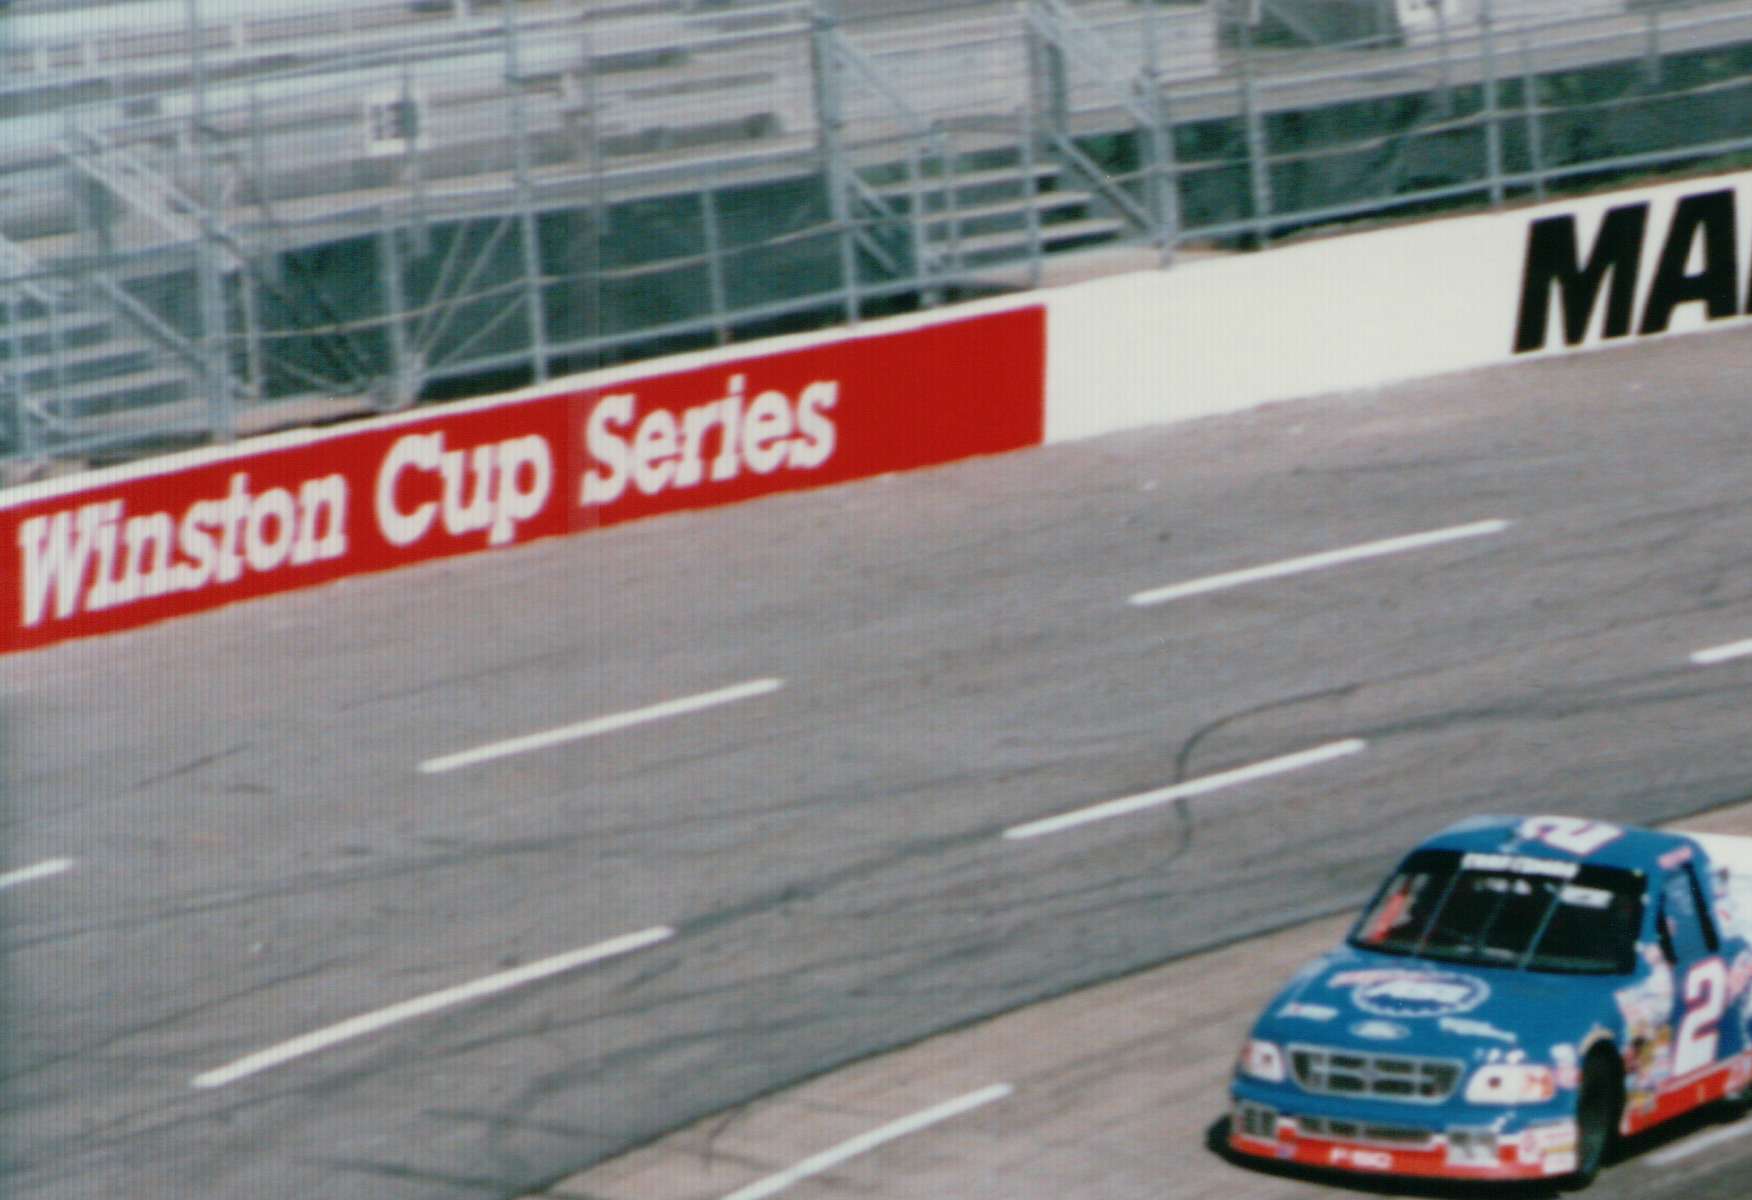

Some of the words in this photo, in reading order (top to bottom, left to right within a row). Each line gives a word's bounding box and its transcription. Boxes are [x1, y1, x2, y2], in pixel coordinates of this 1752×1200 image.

[18, 472, 349, 629] Winston
[374, 429, 555, 549] Cup
[579, 373, 841, 508] Series
[1672, 956, 1728, 1077] 2
